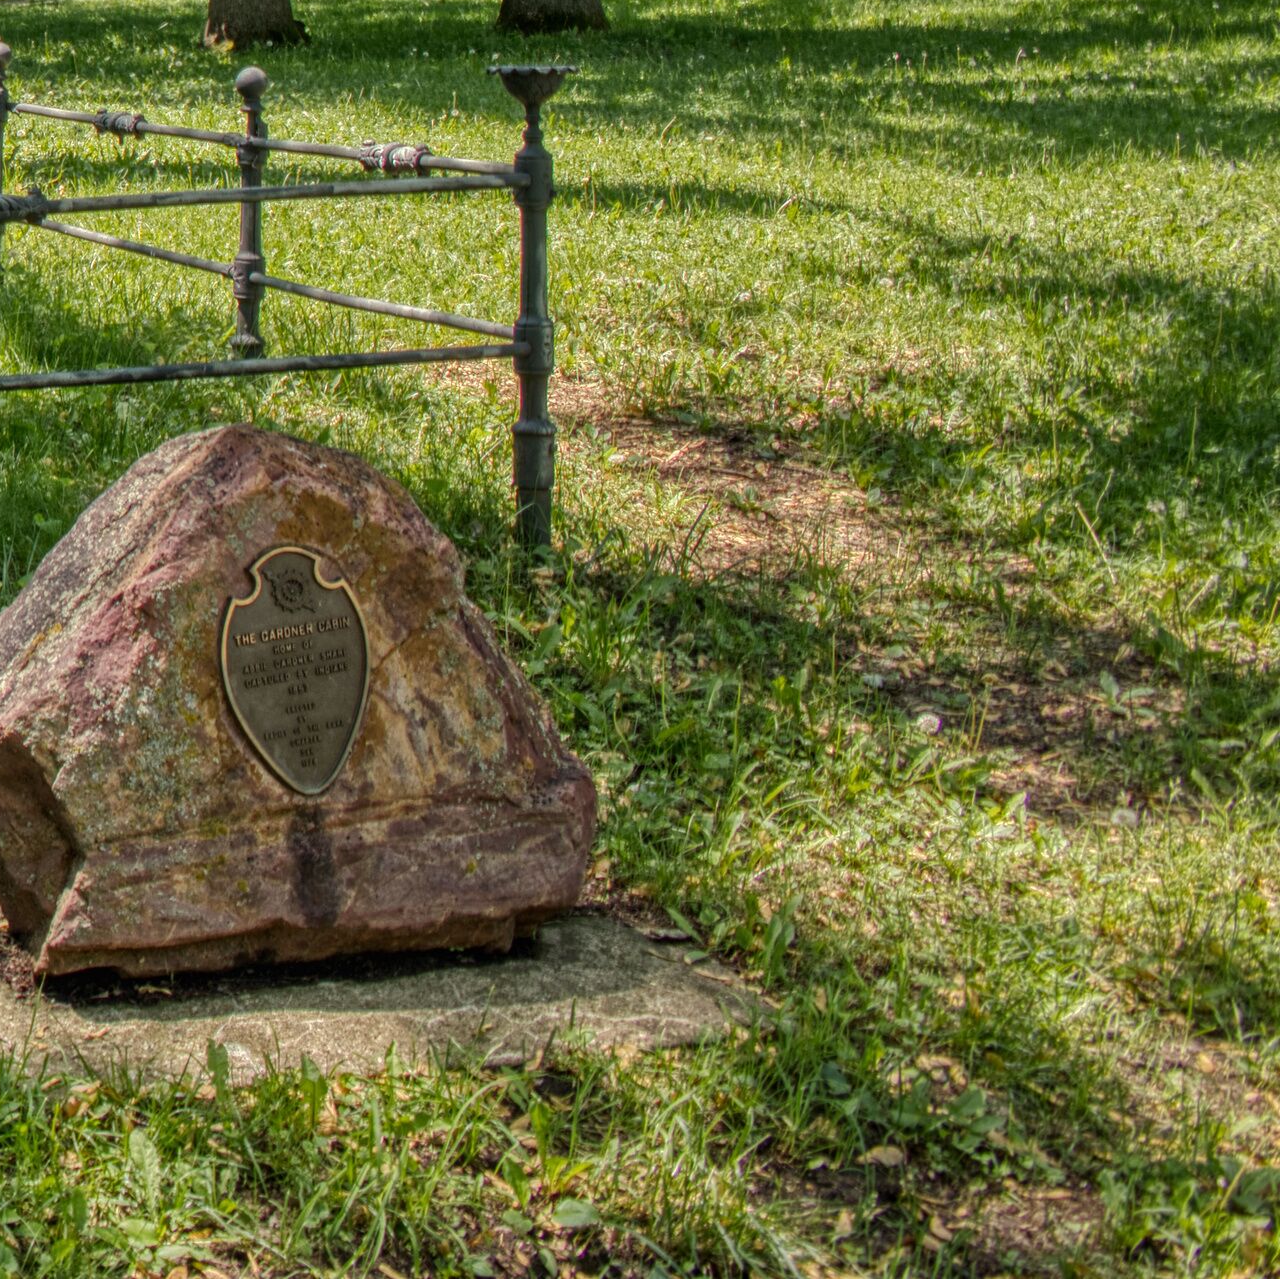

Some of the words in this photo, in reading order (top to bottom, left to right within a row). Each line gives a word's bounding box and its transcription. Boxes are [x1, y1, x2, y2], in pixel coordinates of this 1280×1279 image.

[234, 632, 257, 647] THE
[261, 622, 314, 643] GARDNER
[317, 616, 351, 633] CABIN
[273, 642, 297, 655] HOME
[302, 640, 313, 650] OF
[274, 654, 314, 669] GARDNER
